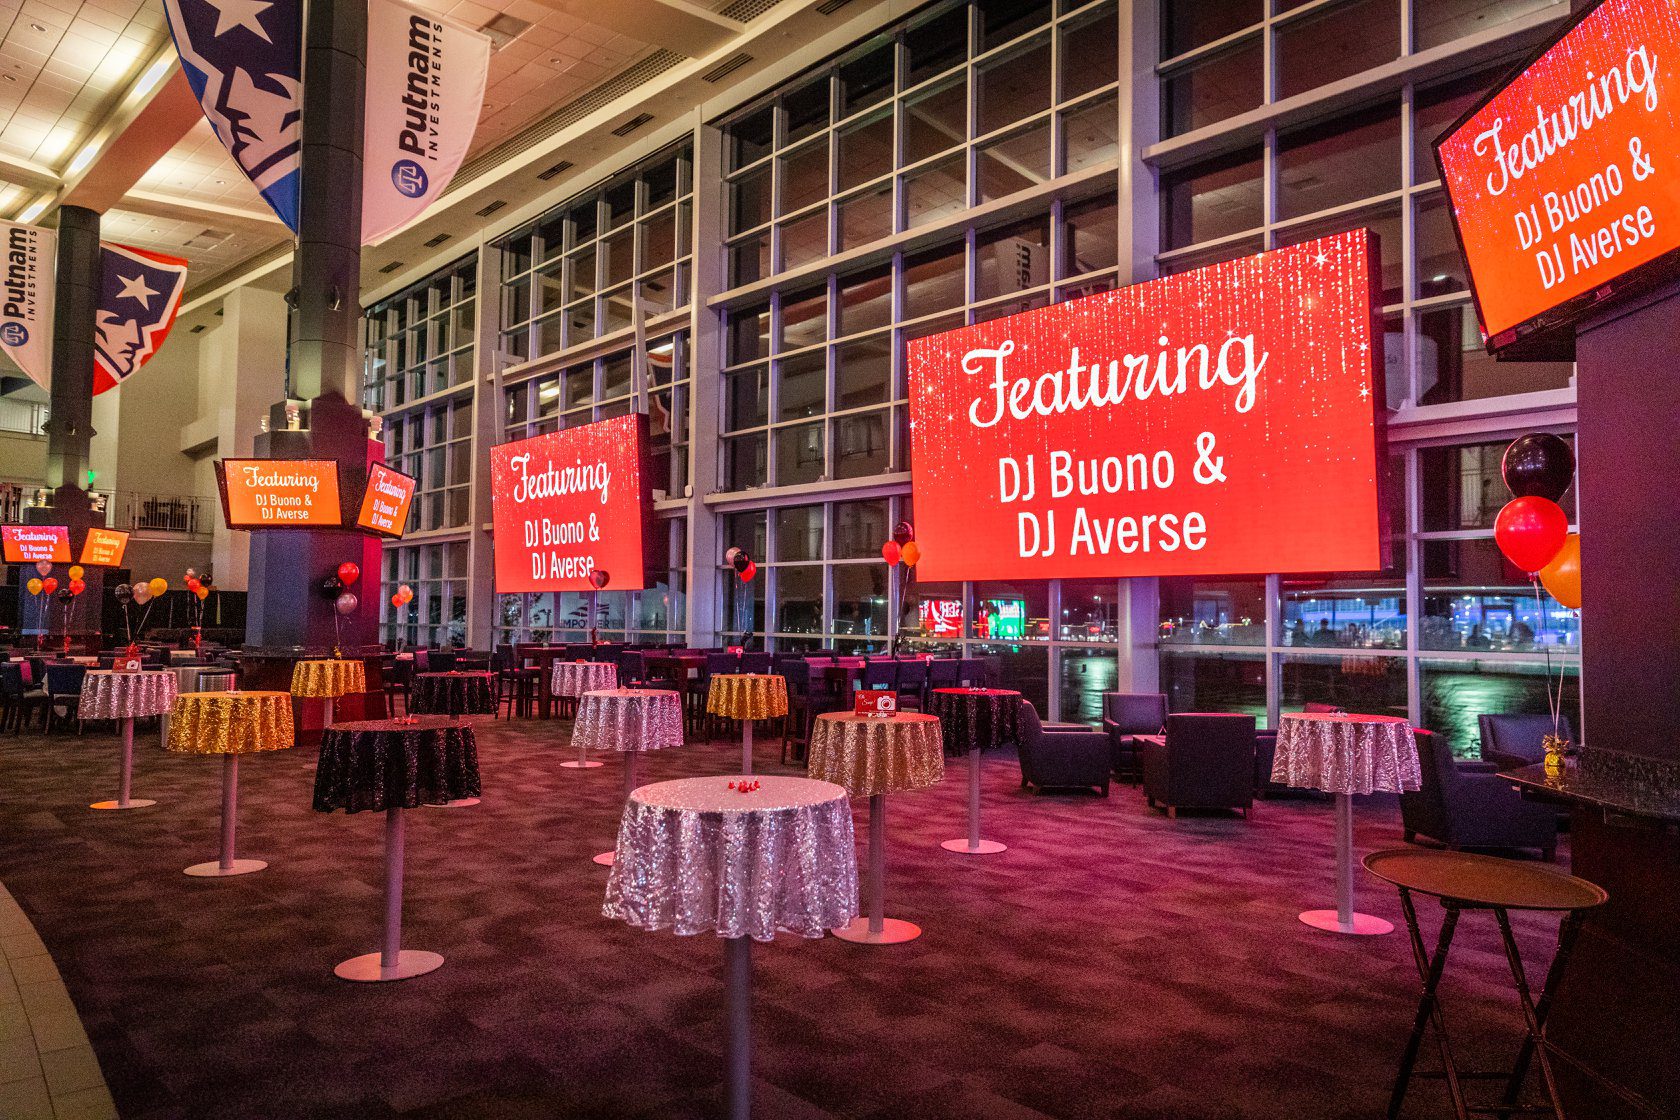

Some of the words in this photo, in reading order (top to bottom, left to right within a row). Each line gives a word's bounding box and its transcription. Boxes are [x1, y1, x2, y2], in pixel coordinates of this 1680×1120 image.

[399, 15, 430, 156] Putnam
[429, 24, 443, 160] INVESTMENTS
[1474, 45, 1658, 196] Featuring
[1514, 204, 1543, 250] DJ
[1544, 164, 1623, 233] Buono
[1629, 136, 1655, 181] &
[1536, 243, 1565, 289] DJ
[1569, 205, 1655, 274] Averse
[3, 227, 27, 319] Putnam
[28, 230, 37, 321] INVESTMENTS
[961, 333, 1269, 428] Featuring
[243, 466, 320, 493] Featuring
[374, 470, 407, 505] Featuring
[510, 452, 612, 505] Featuring
[999, 455, 1036, 503] DJ
[1050, 448, 1175, 498] Buono
[1193, 431, 1227, 485] &
[255, 494, 267, 506] DJ
[270, 494, 302, 506] Buono
[304, 495, 313, 507] &
[262, 507, 274, 520] DJ
[276, 508, 309, 520] Averse
[371, 513, 378, 526] DJ
[378, 514, 393, 529] Averse
[373, 499, 379, 512] DJ
[379, 501, 394, 515] Buono
[394, 505, 399, 517] &
[12, 529, 58, 544] Featuring
[49, 544, 54, 552] &
[525, 520, 539, 548] DJ
[542, 518, 585, 546] Buono
[588, 512, 600, 542] &
[1018, 510, 1055, 558] DJ
[1069, 507, 1208, 556] Averse
[23, 552, 31, 560] DJ
[32, 552, 53, 560] Averse
[532, 552, 546, 580] DJ
[550, 551, 594, 579] Averse
